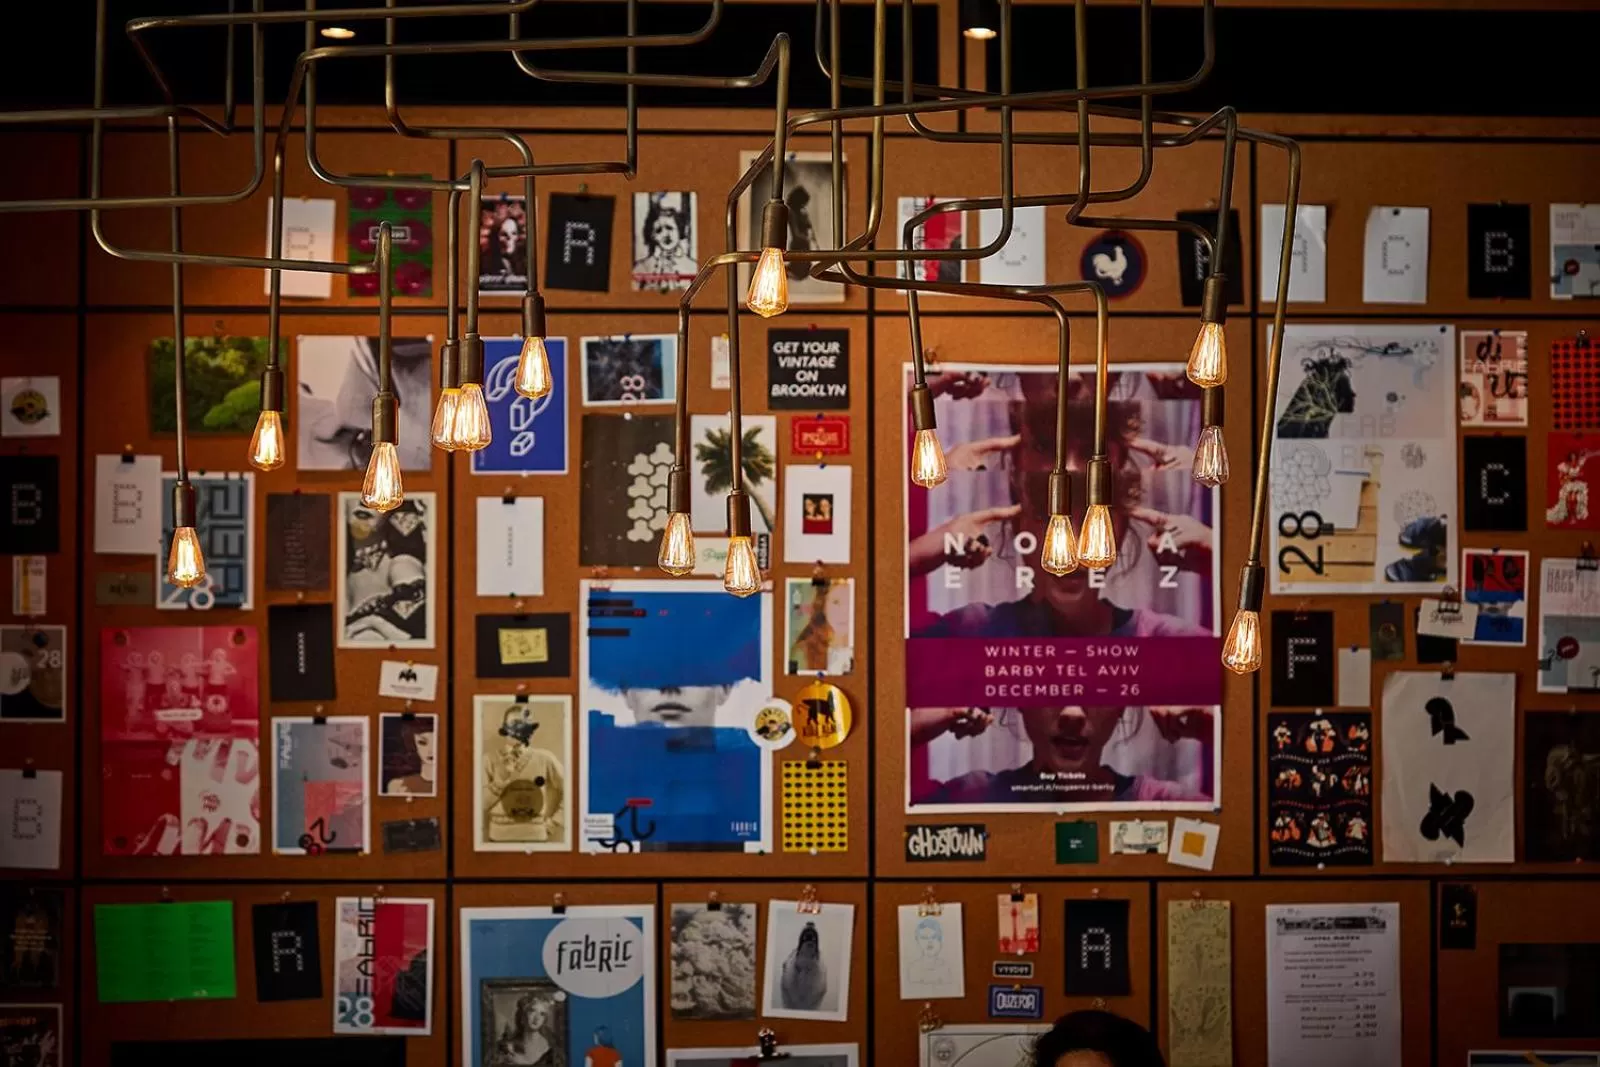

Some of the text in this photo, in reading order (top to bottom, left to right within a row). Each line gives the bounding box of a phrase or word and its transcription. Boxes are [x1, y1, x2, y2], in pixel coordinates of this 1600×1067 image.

[564, 221, 596, 265] R
[1484, 231, 1514, 273] B
[772, 341, 841, 354] GET YOUR
[778, 355, 837, 369] VINTAGE
[771, 384, 847, 397] BROOKLYN
[795, 370, 819, 382] ON
[12, 483, 42, 525] B
[113, 483, 143, 525] B
[1481, 462, 1511, 505] C
[36, 650, 62, 667] 28
[984, 645, 1057, 657] WINTER
[1086, 645, 1140, 657] SHOW
[984, 664, 1141, 677] BARBY TEL AVIV
[1287, 637, 1318, 680] F
[984, 684, 1085, 697] DECEMBER
[1120, 684, 1141, 696] 26
[12, 799, 43, 840] B
[271, 930, 303, 972] R
[1081, 927, 1111, 969] A
